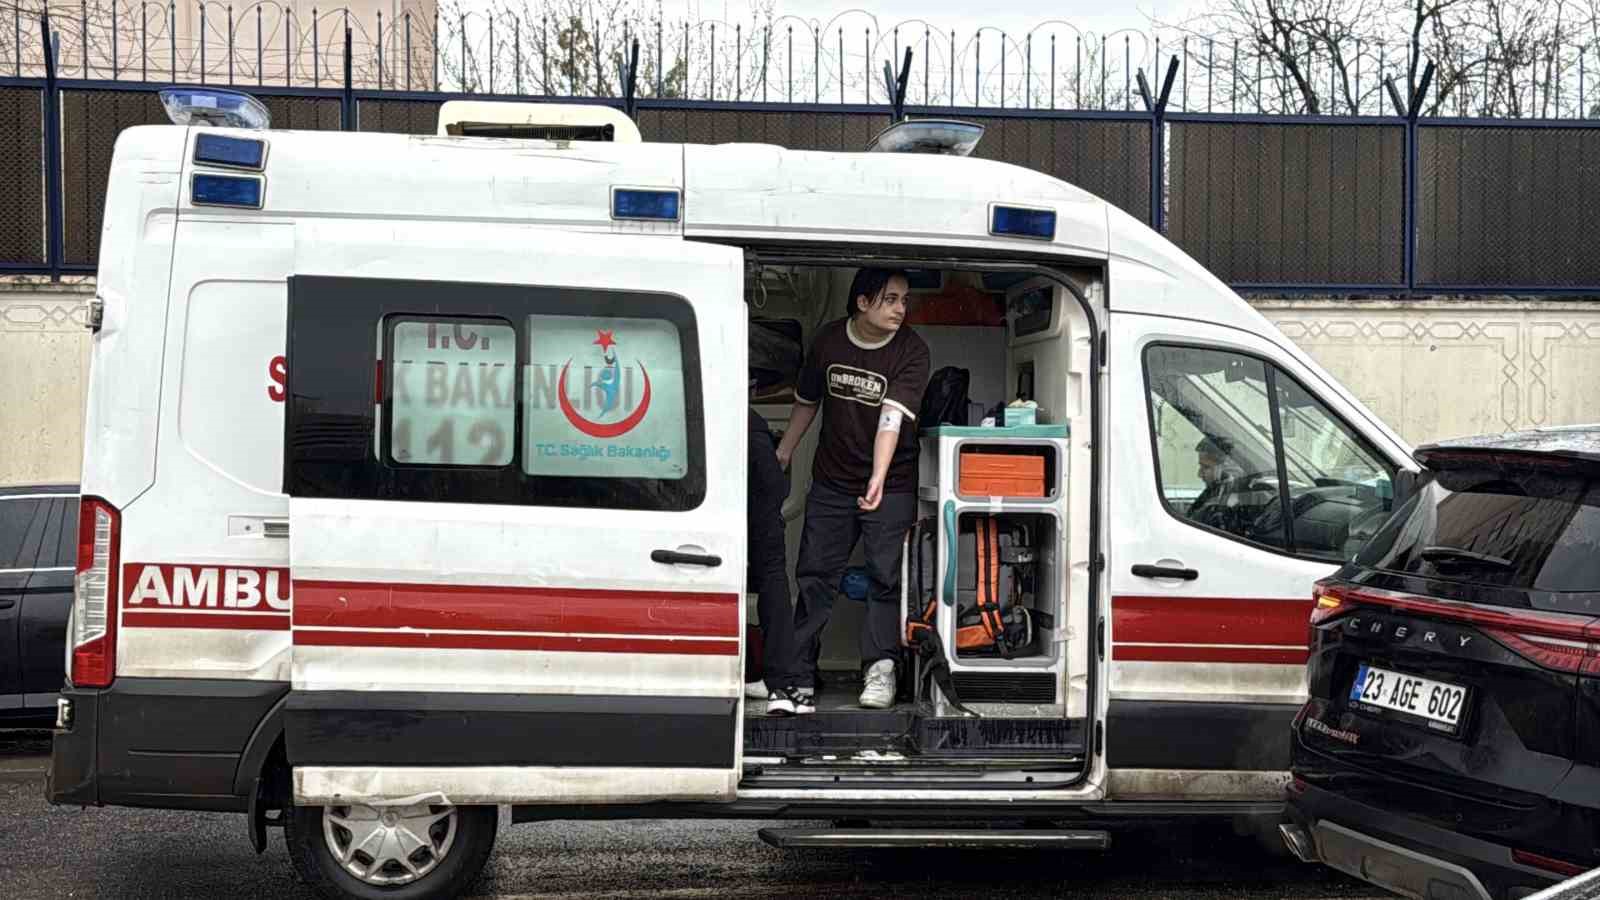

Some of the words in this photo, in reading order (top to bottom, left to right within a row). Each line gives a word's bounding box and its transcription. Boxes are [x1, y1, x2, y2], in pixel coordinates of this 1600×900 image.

[1350, 618, 1472, 647] CHERY
[1362, 671, 1385, 701] 23
[1388, 676, 1423, 711] AGE
[1427, 685, 1463, 720] 602
